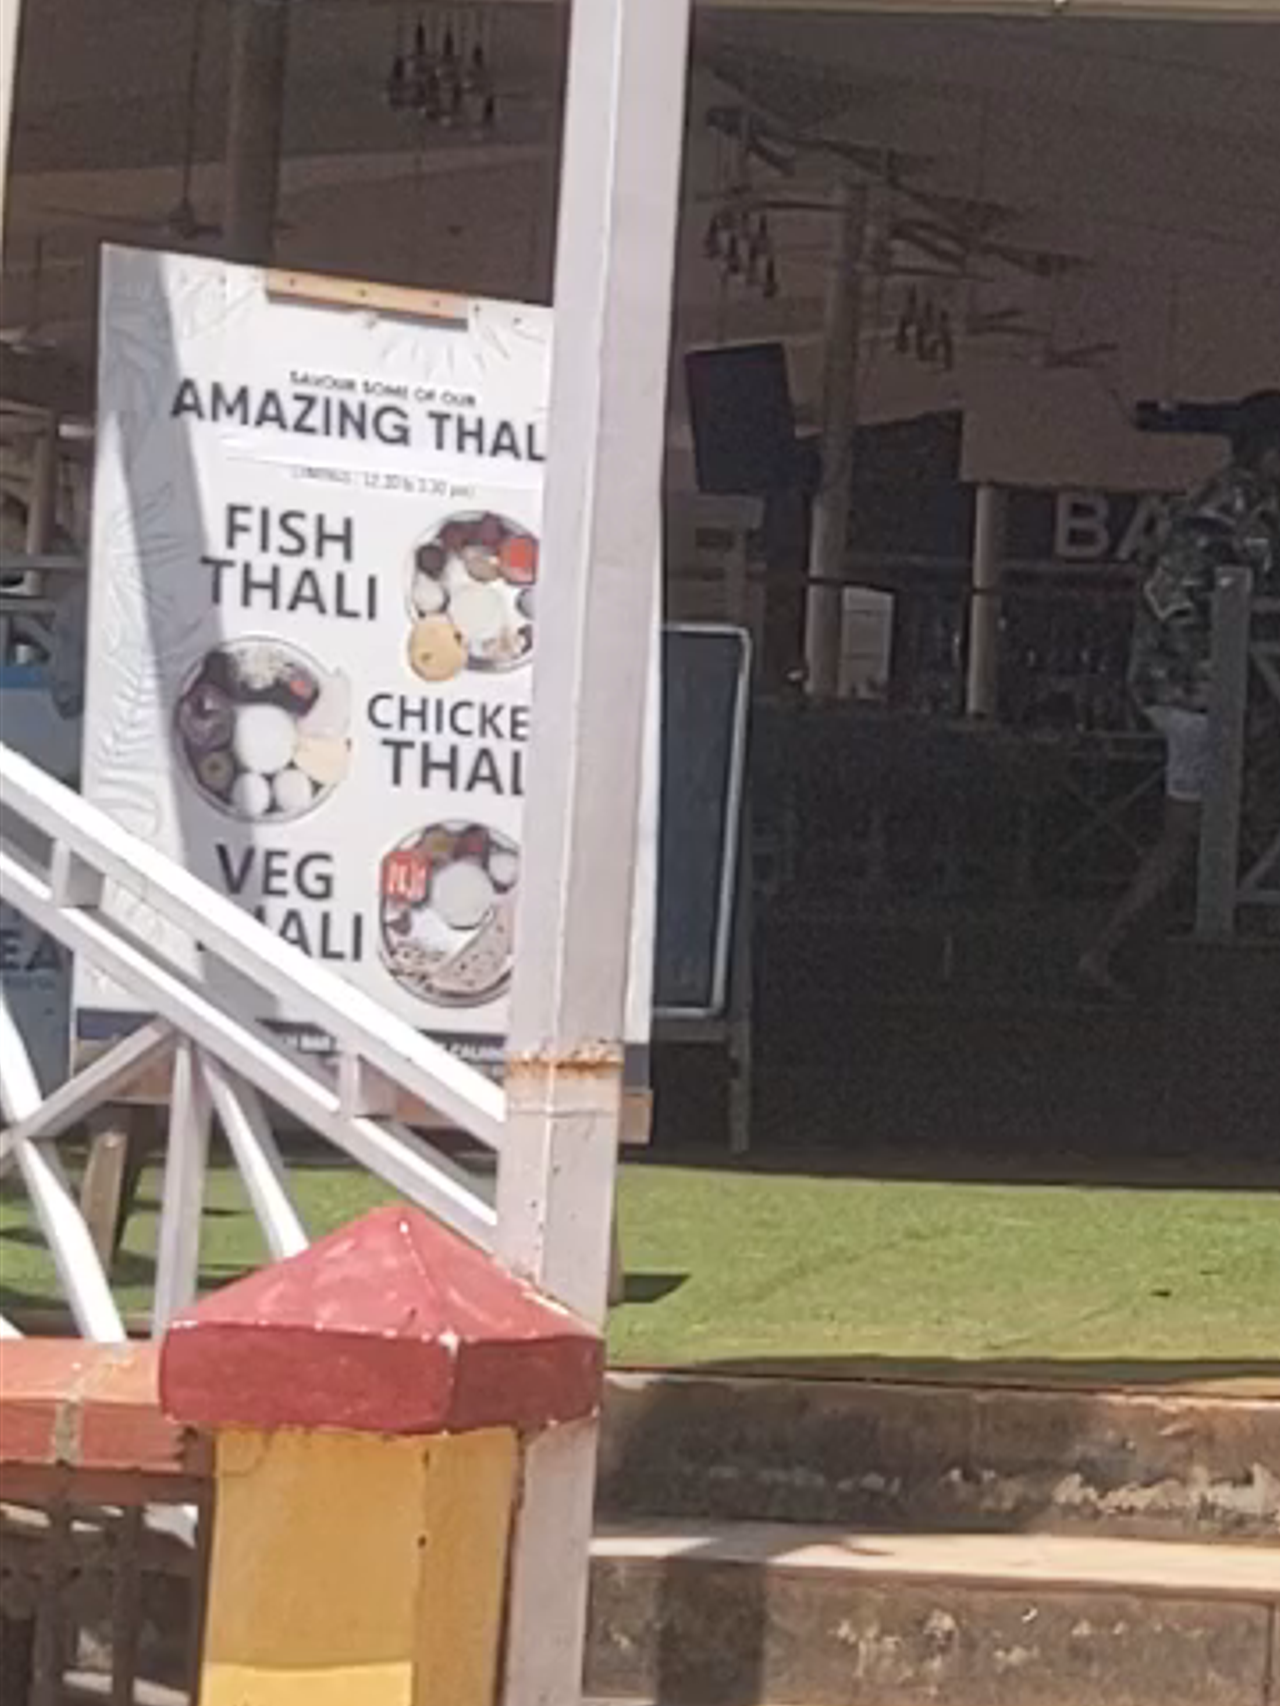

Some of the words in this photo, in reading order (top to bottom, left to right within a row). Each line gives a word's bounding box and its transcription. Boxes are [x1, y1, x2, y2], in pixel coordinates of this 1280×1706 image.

[170, 377, 411, 448] AMAZING
[427, 409, 546, 462] THAL
[224, 504, 354, 562] FISH
[1054, 490, 1172, 560] BA
[200, 555, 379, 622] THALI
[366, 693, 532, 743] CHICKE
[379, 738, 523, 797] THAL
[215, 843, 333, 900] VEG
